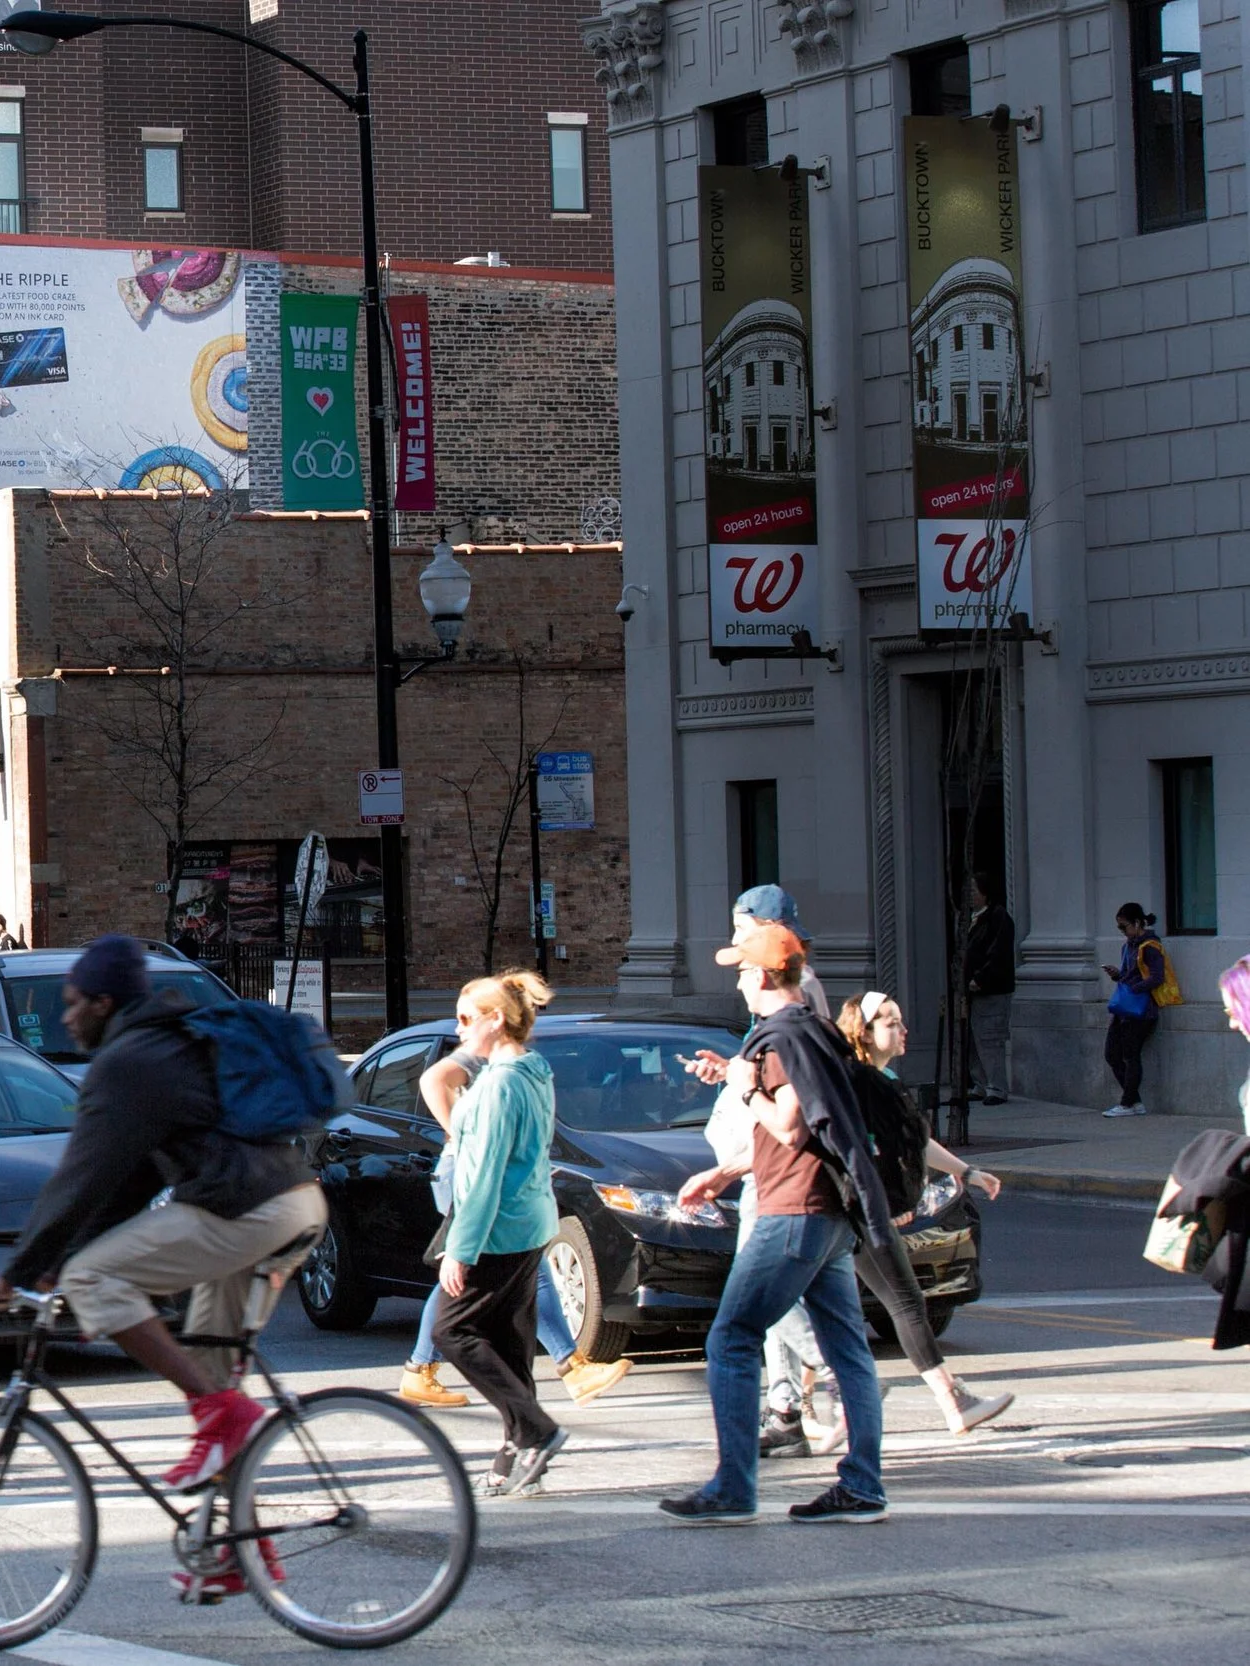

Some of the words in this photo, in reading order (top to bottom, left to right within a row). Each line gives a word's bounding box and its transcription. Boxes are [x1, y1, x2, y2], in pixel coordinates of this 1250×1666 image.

[914, 141, 931, 251] BUCKTOWN
[998, 179, 1013, 253] WICKER
[710, 189, 726, 293] BUCKTOWN
[789, 227, 803, 294] WICKER
[18, 273, 69, 287] RIPPLE
[27, 292, 49, 301] FOOD
[51, 293, 76, 301] CRAZE
[6, 302, 27, 310] WITH
[29, 303, 54, 312] 80,000
[14, 312, 26, 320] AN
[27, 313, 42, 321] INK
[289, 325, 348, 351] WPB
[46, 366, 67, 376] VISA
[401, 322, 426, 483] WELCOME!
[316, 430, 330, 438] THE
[931, 490, 961, 509] open
[962, 487, 978, 500] 24
[980, 477, 1015, 496] hours
[723, 516, 751, 534] open
[753, 513, 769, 526] 24
[770, 504, 803, 522] hours
[572, 763, 590, 771] stop
[381, 815, 401, 823] ZONE
